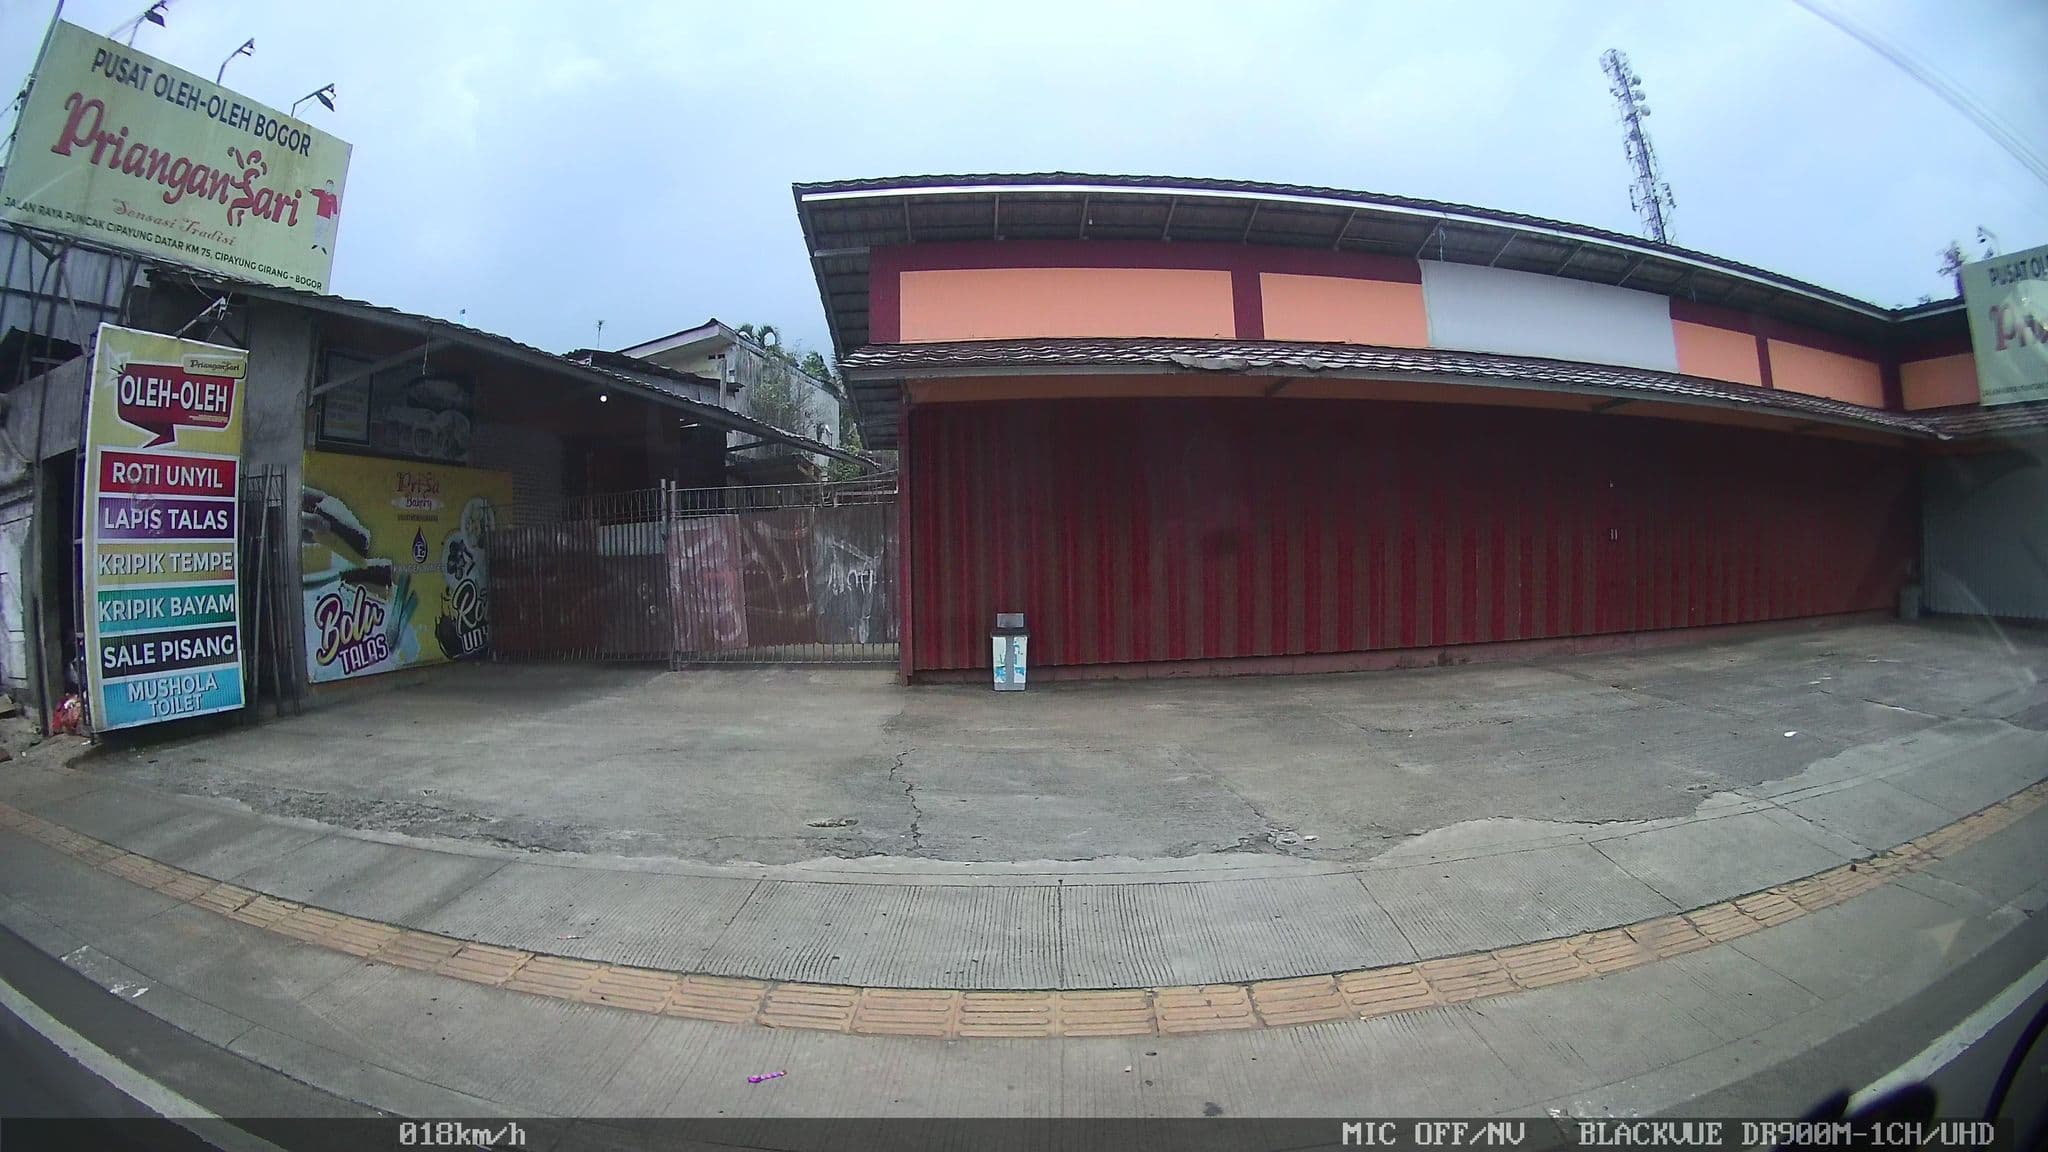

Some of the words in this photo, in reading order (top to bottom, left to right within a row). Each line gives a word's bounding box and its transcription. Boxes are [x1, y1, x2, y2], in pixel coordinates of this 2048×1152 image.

[92, 48, 152, 91] PUSAT
[153, 73, 253, 132] OLEH-OLEH
[253, 113, 311, 157] BOGOR
[112, 199, 175, 229] Sensasi
[180, 217, 238, 247] Tradisi
[37, 204, 63, 220] RAYA
[63, 211, 106, 231] PUNCAK
[106, 222, 153, 243] CIPAYUNG
[154, 235, 184, 251] DATAR
[185, 243, 200, 255] KM
[214, 250, 257, 271] CIPAYUNG
[257, 263, 289, 280] GIRANG
[295, 274, 323, 291] BOGOR
[1988, 259, 2028, 287] PUSAT
[120, 374, 228, 413] OLEH-OLEH
[112, 462, 160, 485] ROTI
[166, 465, 223, 489] UNYIL
[104, 507, 162, 530] LAPIS
[168, 508, 228, 530] TALAS
[99, 552, 166, 576] KRIPIK
[169, 551, 234, 573] TEMPE
[99, 597, 166, 622] KRIPIK
[170, 593, 235, 617] BAYAM
[315, 584, 385, 666] Bolu
[104, 642, 155, 669] SALE
[161, 635, 234, 662] PISANG
[338, 636, 388, 675] TALAS
[127, 672, 218, 702] MUSHOLA
[149, 694, 203, 717] TOILET
